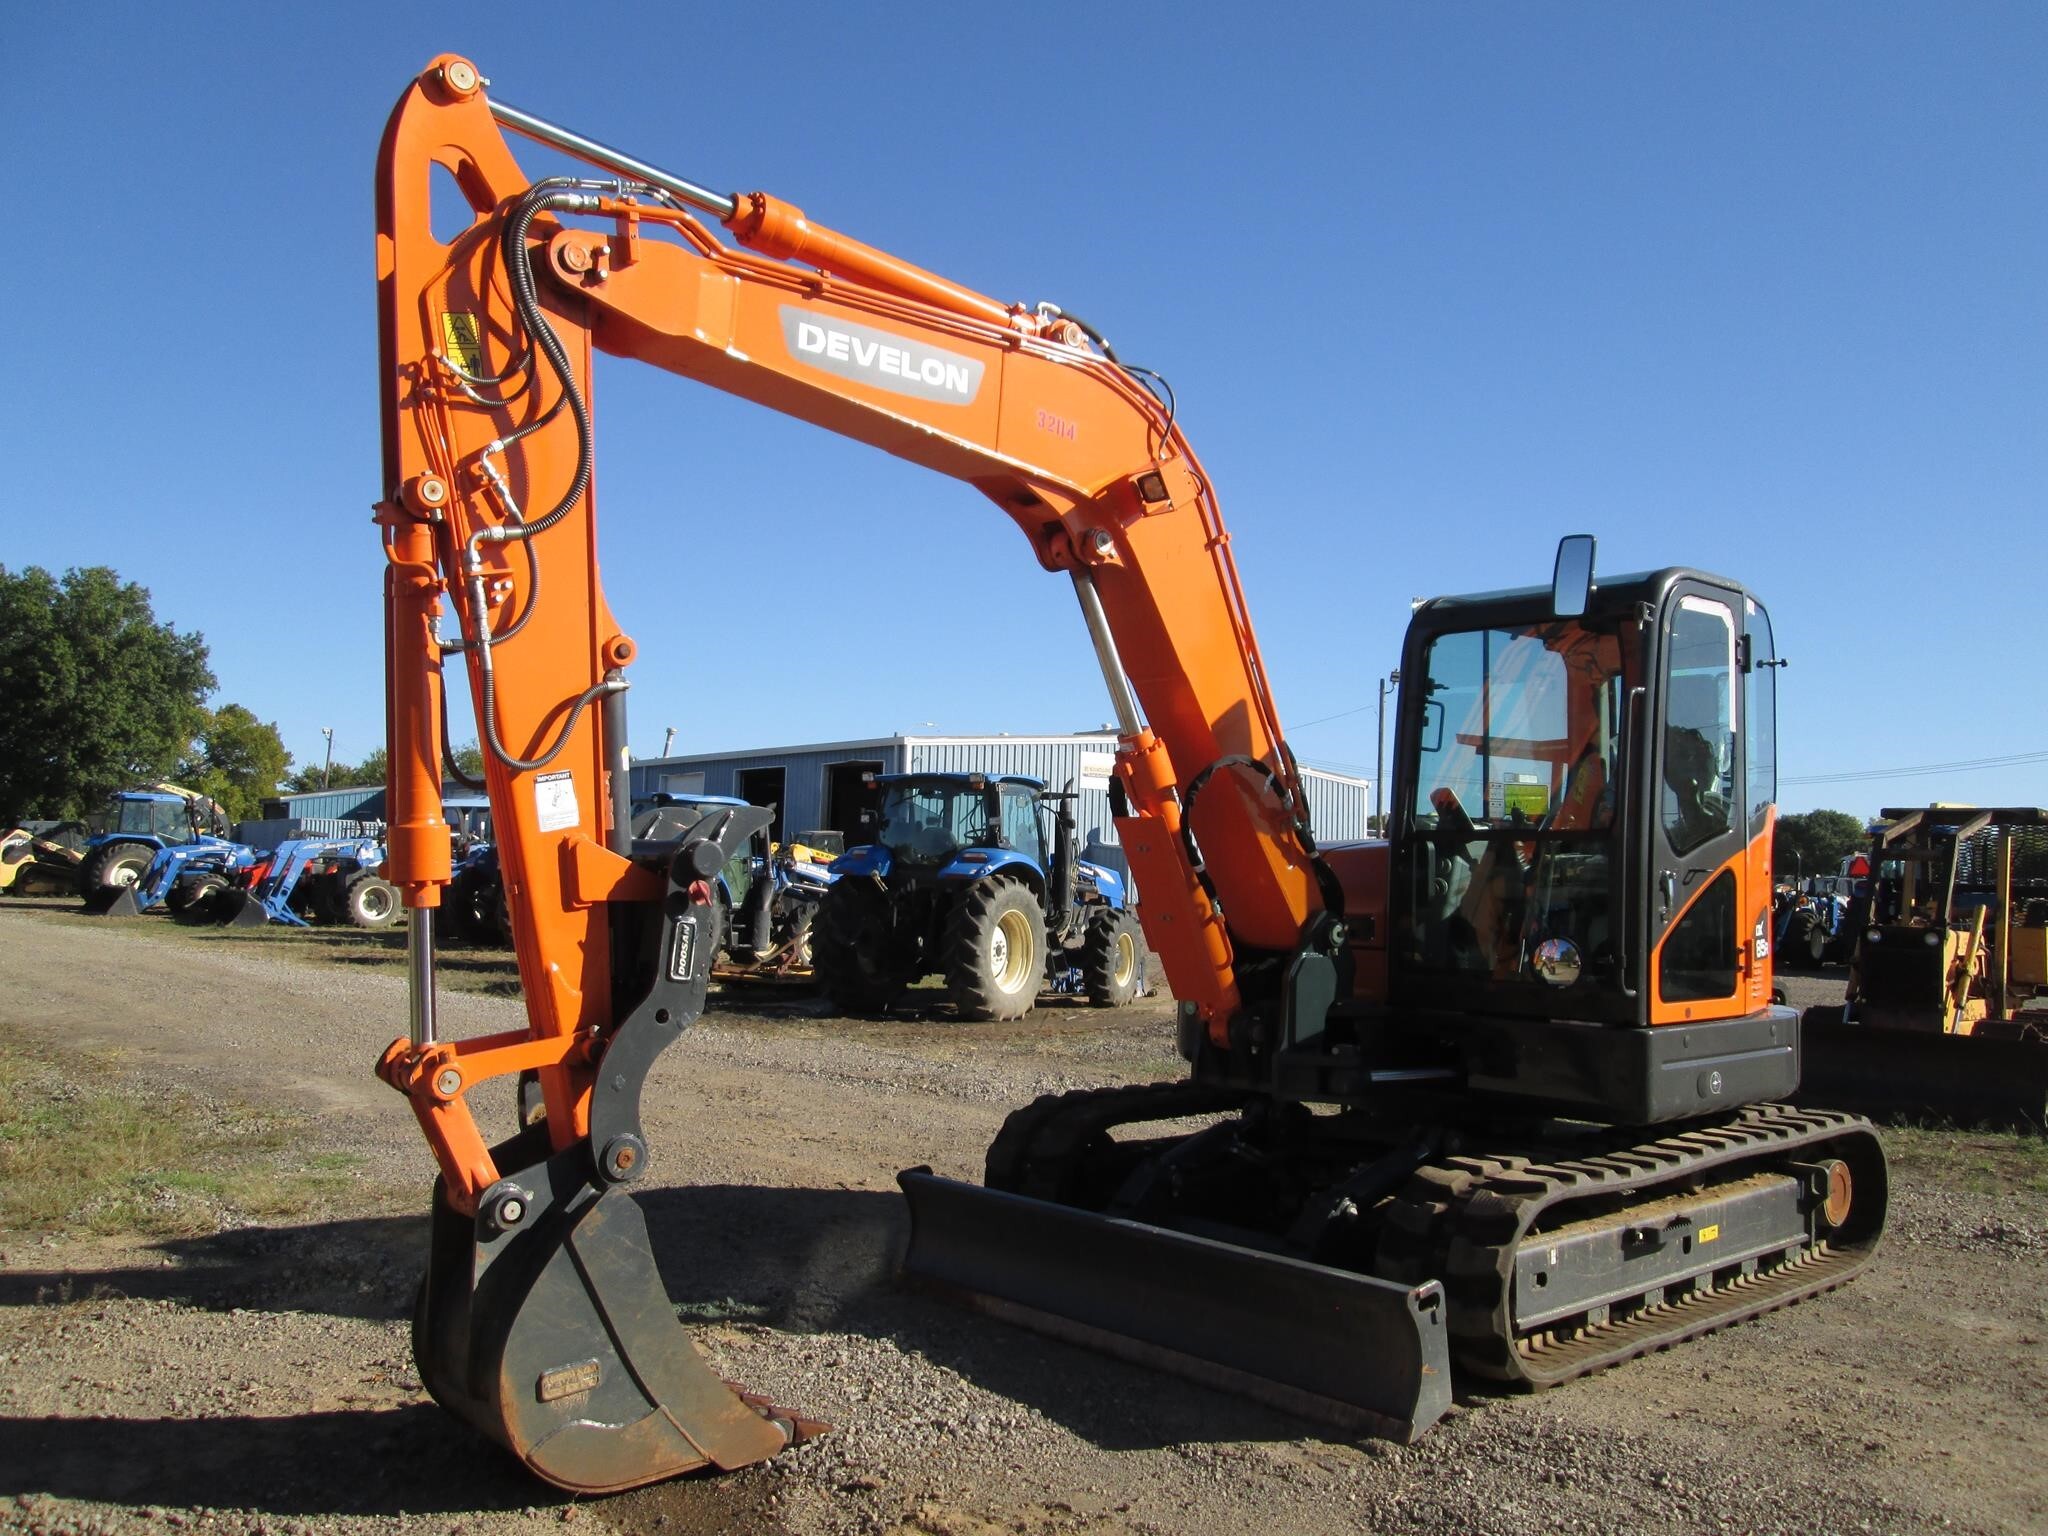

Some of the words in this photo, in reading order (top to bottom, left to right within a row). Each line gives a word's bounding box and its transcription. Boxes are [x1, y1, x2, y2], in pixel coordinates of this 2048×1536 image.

[797, 321, 970, 395] DEVELON
[1037, 410, 1075, 441] 32114
[536, 771, 571, 783] IMPORTANT
[678, 922, 691, 976] DOOSAN
